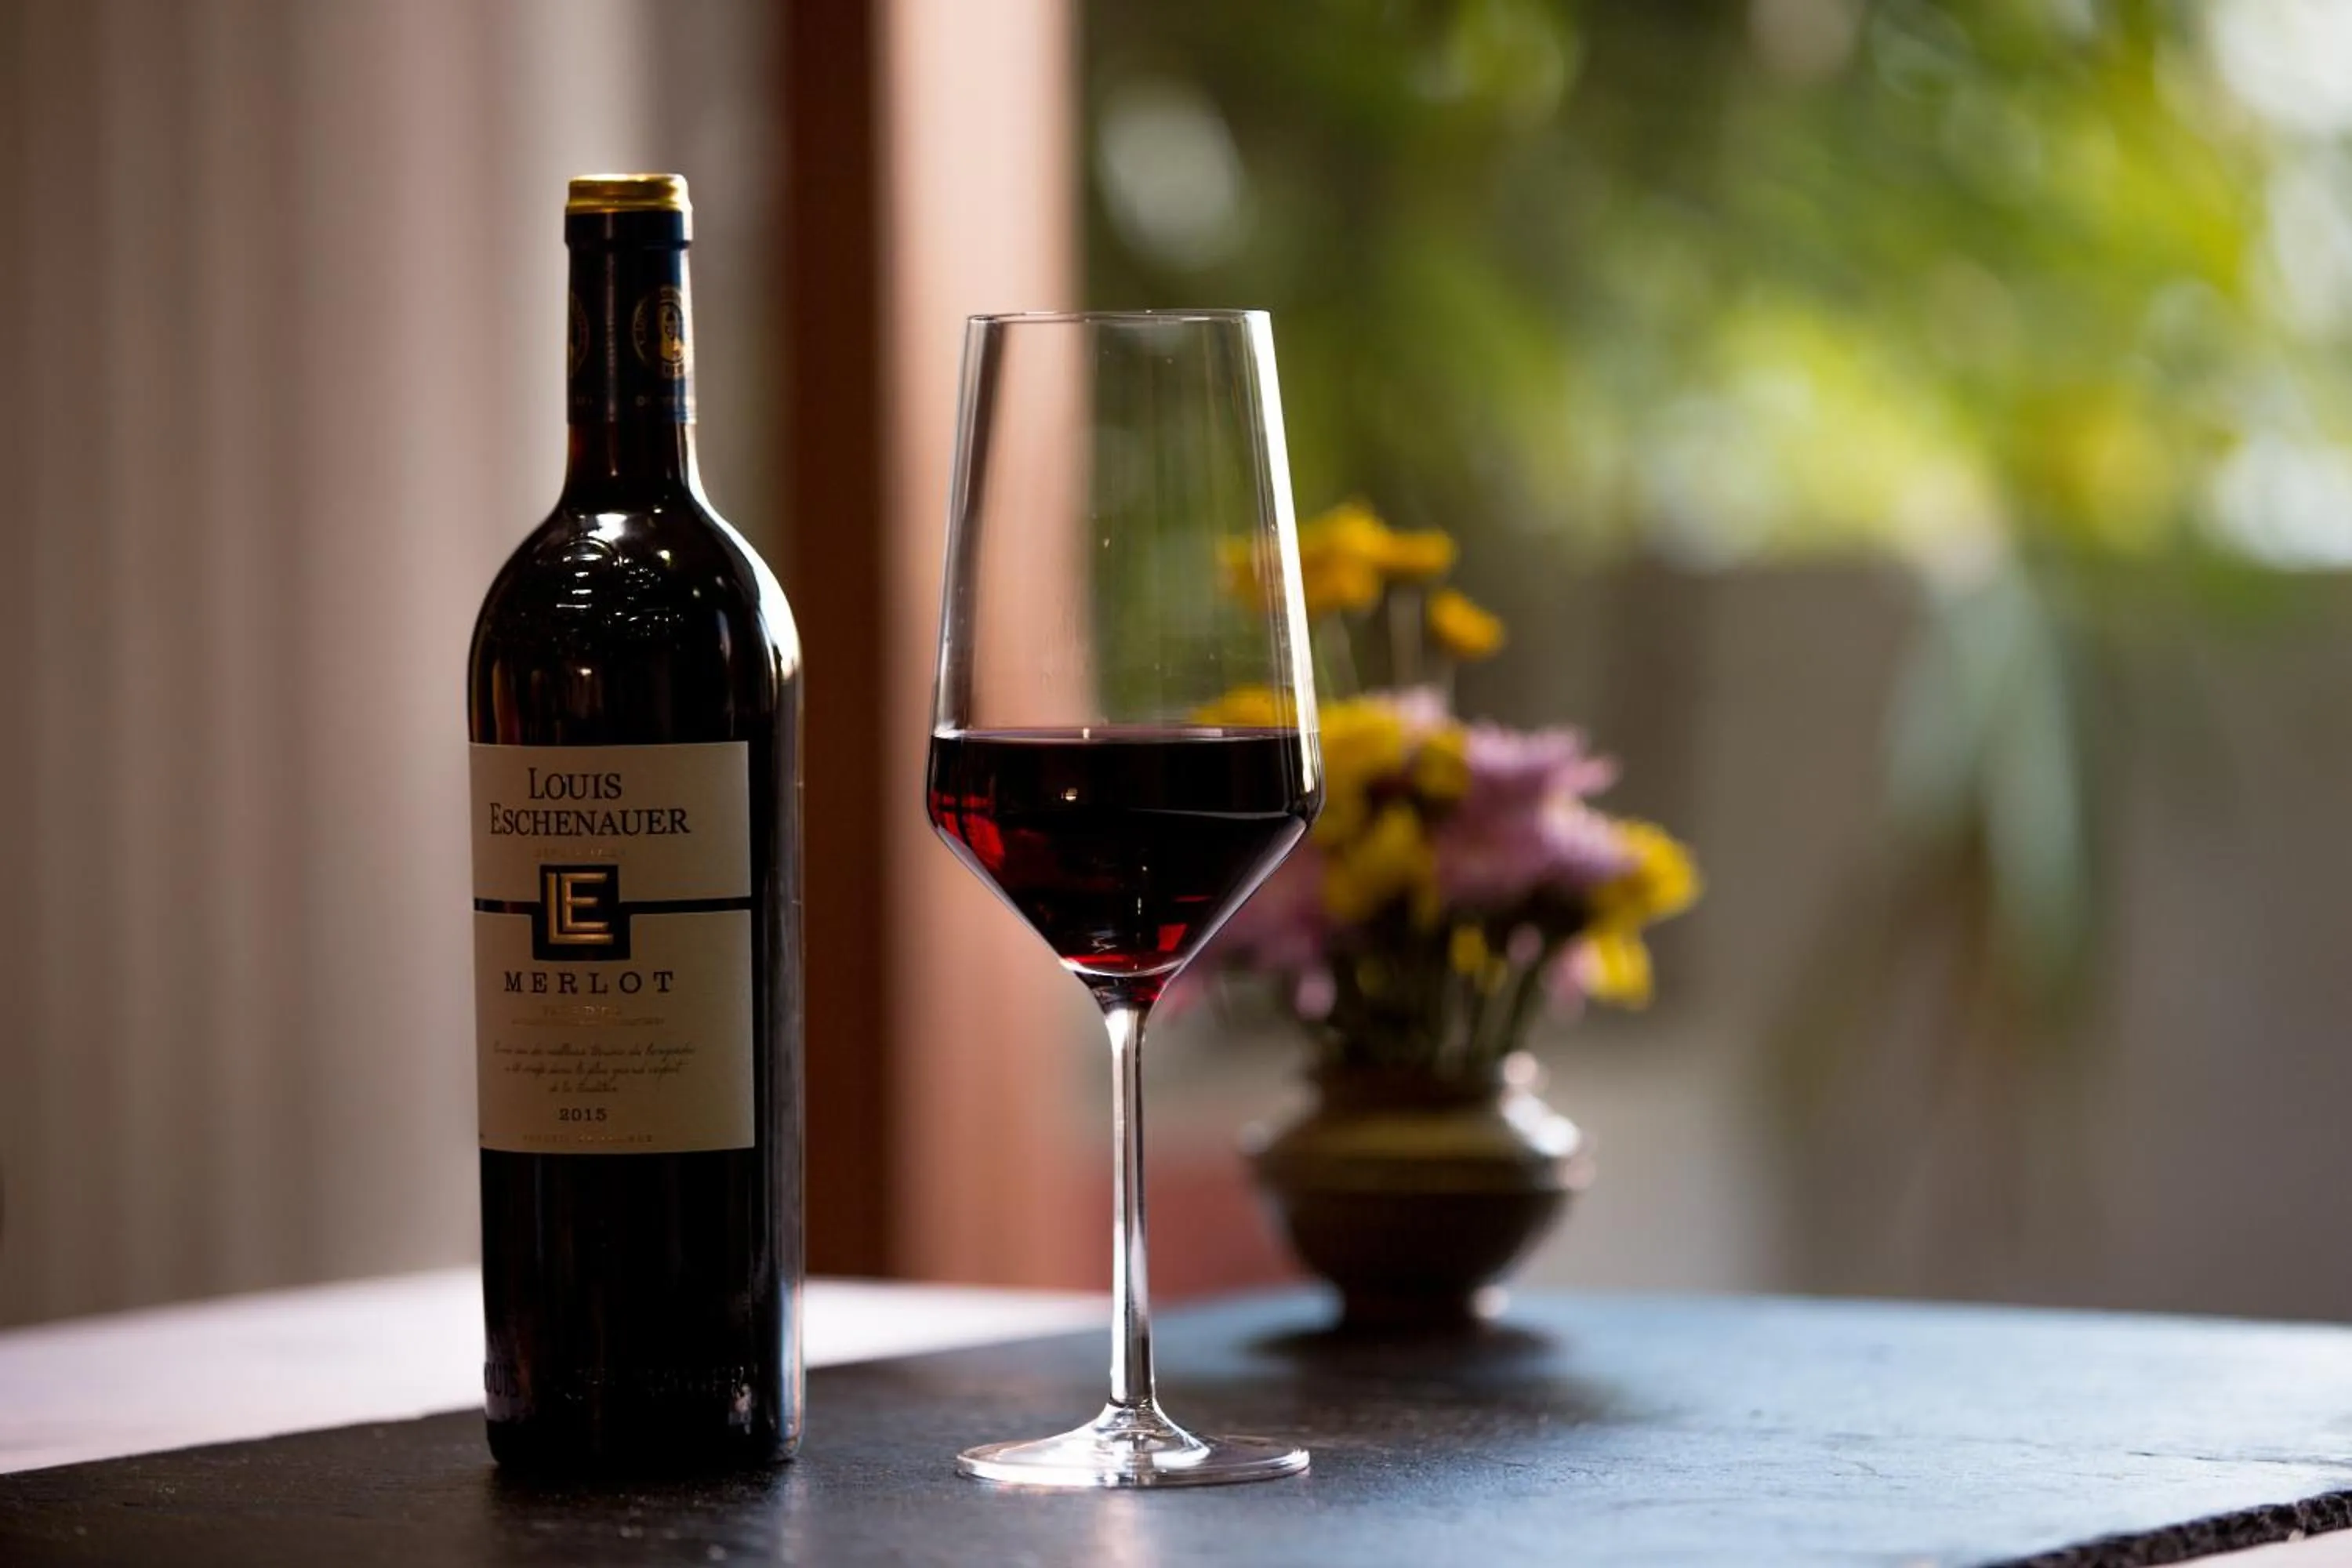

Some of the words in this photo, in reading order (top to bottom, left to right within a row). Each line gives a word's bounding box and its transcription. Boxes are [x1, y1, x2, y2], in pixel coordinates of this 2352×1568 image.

[528, 767, 622, 800] LOUIS
[490, 802, 691, 837] ESCHENAUER
[504, 971, 674, 995] MERLOT
[558, 1108, 608, 1122] 2015
